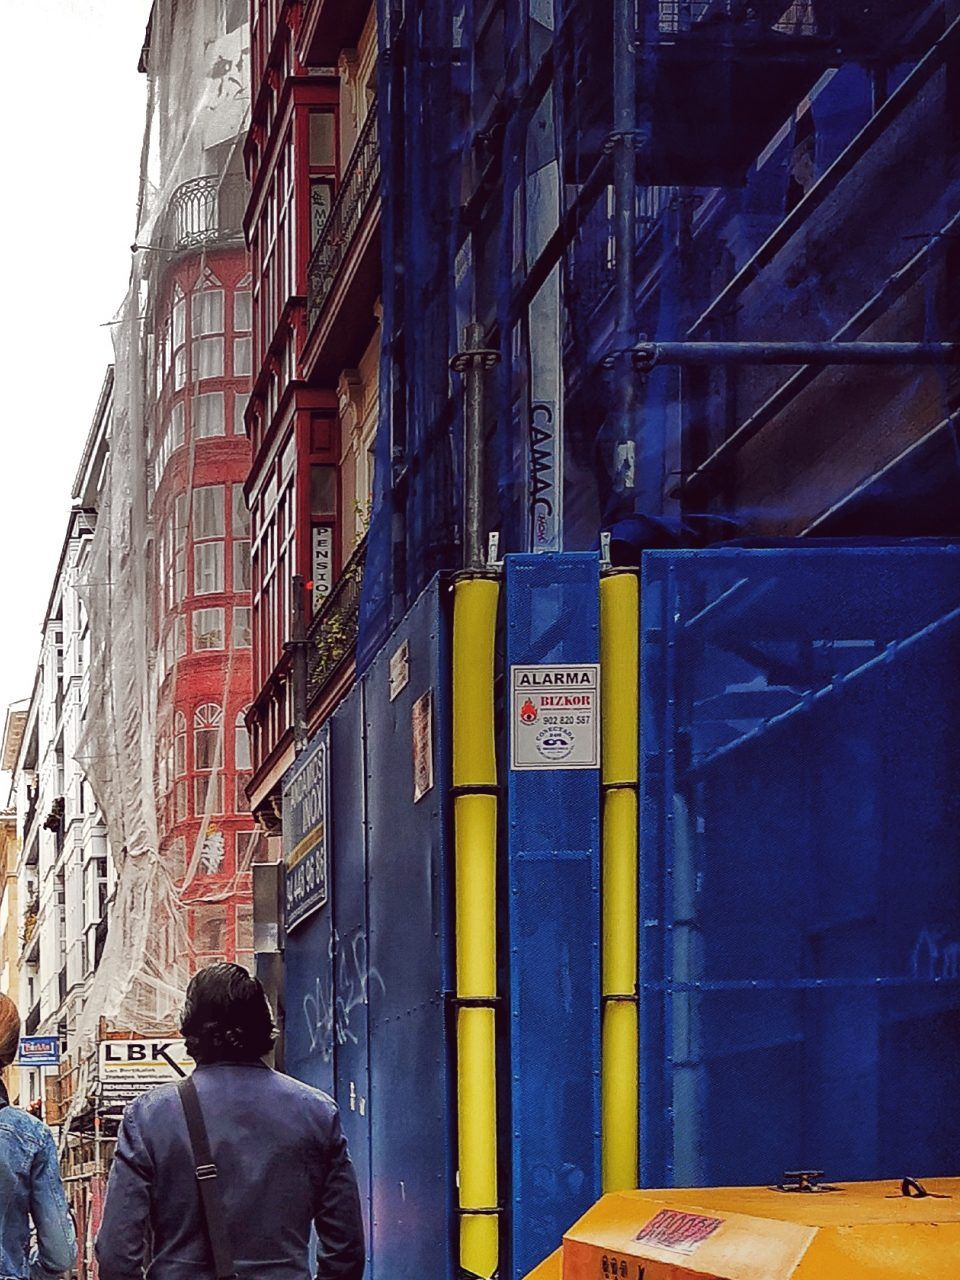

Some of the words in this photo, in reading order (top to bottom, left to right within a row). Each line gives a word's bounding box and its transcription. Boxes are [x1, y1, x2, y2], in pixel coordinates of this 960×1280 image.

[530, 404, 553, 518] CAMAC
[520, 673, 591, 685] ALARMA
[540, 695, 591, 706] BIZKOR
[543, 716, 558, 725] 902
[560, 716, 574, 725] 820
[576, 715, 590, 725] 587
[105, 1044, 186, 1078] LBK
